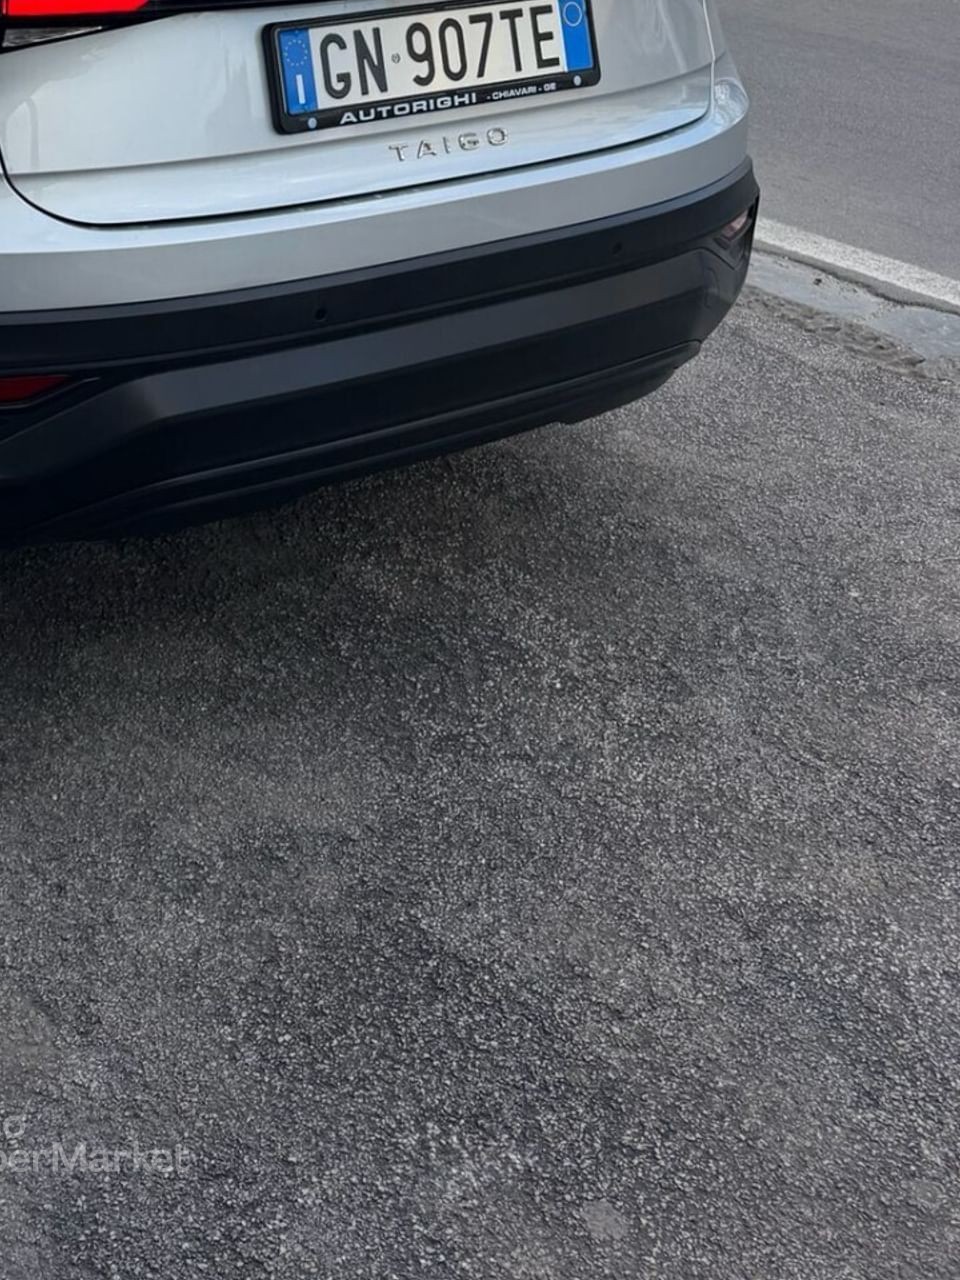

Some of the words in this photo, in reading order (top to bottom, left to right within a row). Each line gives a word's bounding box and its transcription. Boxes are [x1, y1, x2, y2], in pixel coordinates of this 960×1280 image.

[319, 26, 389, 100] GN
[405, 3, 561, 87] 907TE
[339, 91, 478, 125] AUTORIGHI
[492, 85, 537, 100] CHIAVARI
[388, 126, 509, 163] TAIGO
